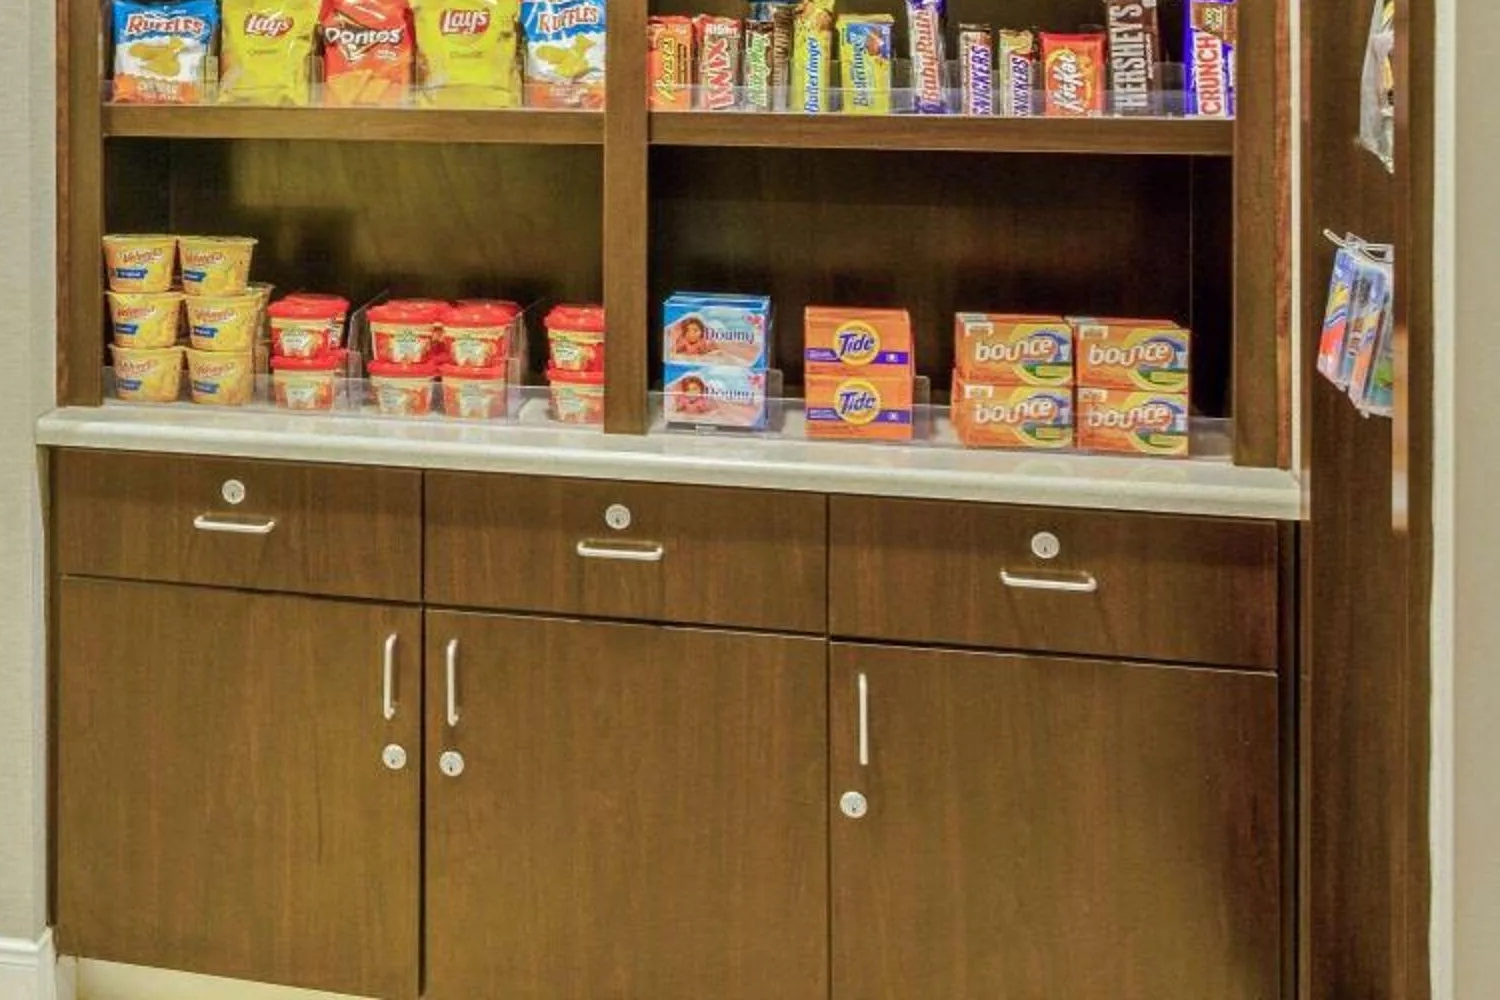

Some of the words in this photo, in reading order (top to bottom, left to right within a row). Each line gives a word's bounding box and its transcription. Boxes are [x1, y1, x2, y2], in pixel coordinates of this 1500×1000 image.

[443, 9, 489, 35] Lay's
[538, 5, 599, 33] RUFFLES
[325, 27, 401, 48] Doritos
[1110, 3, 1148, 115] HERSHEY'S
[1200, 31, 1221, 115] CRUNCH
[838, 332, 875, 356] Tide
[975, 337, 1053, 362] bounce
[1088, 341, 1169, 367] bounce
[838, 391, 875, 415] Tide
[976, 398, 1053, 424] bounce
[1087, 402, 1168, 429] bounce
